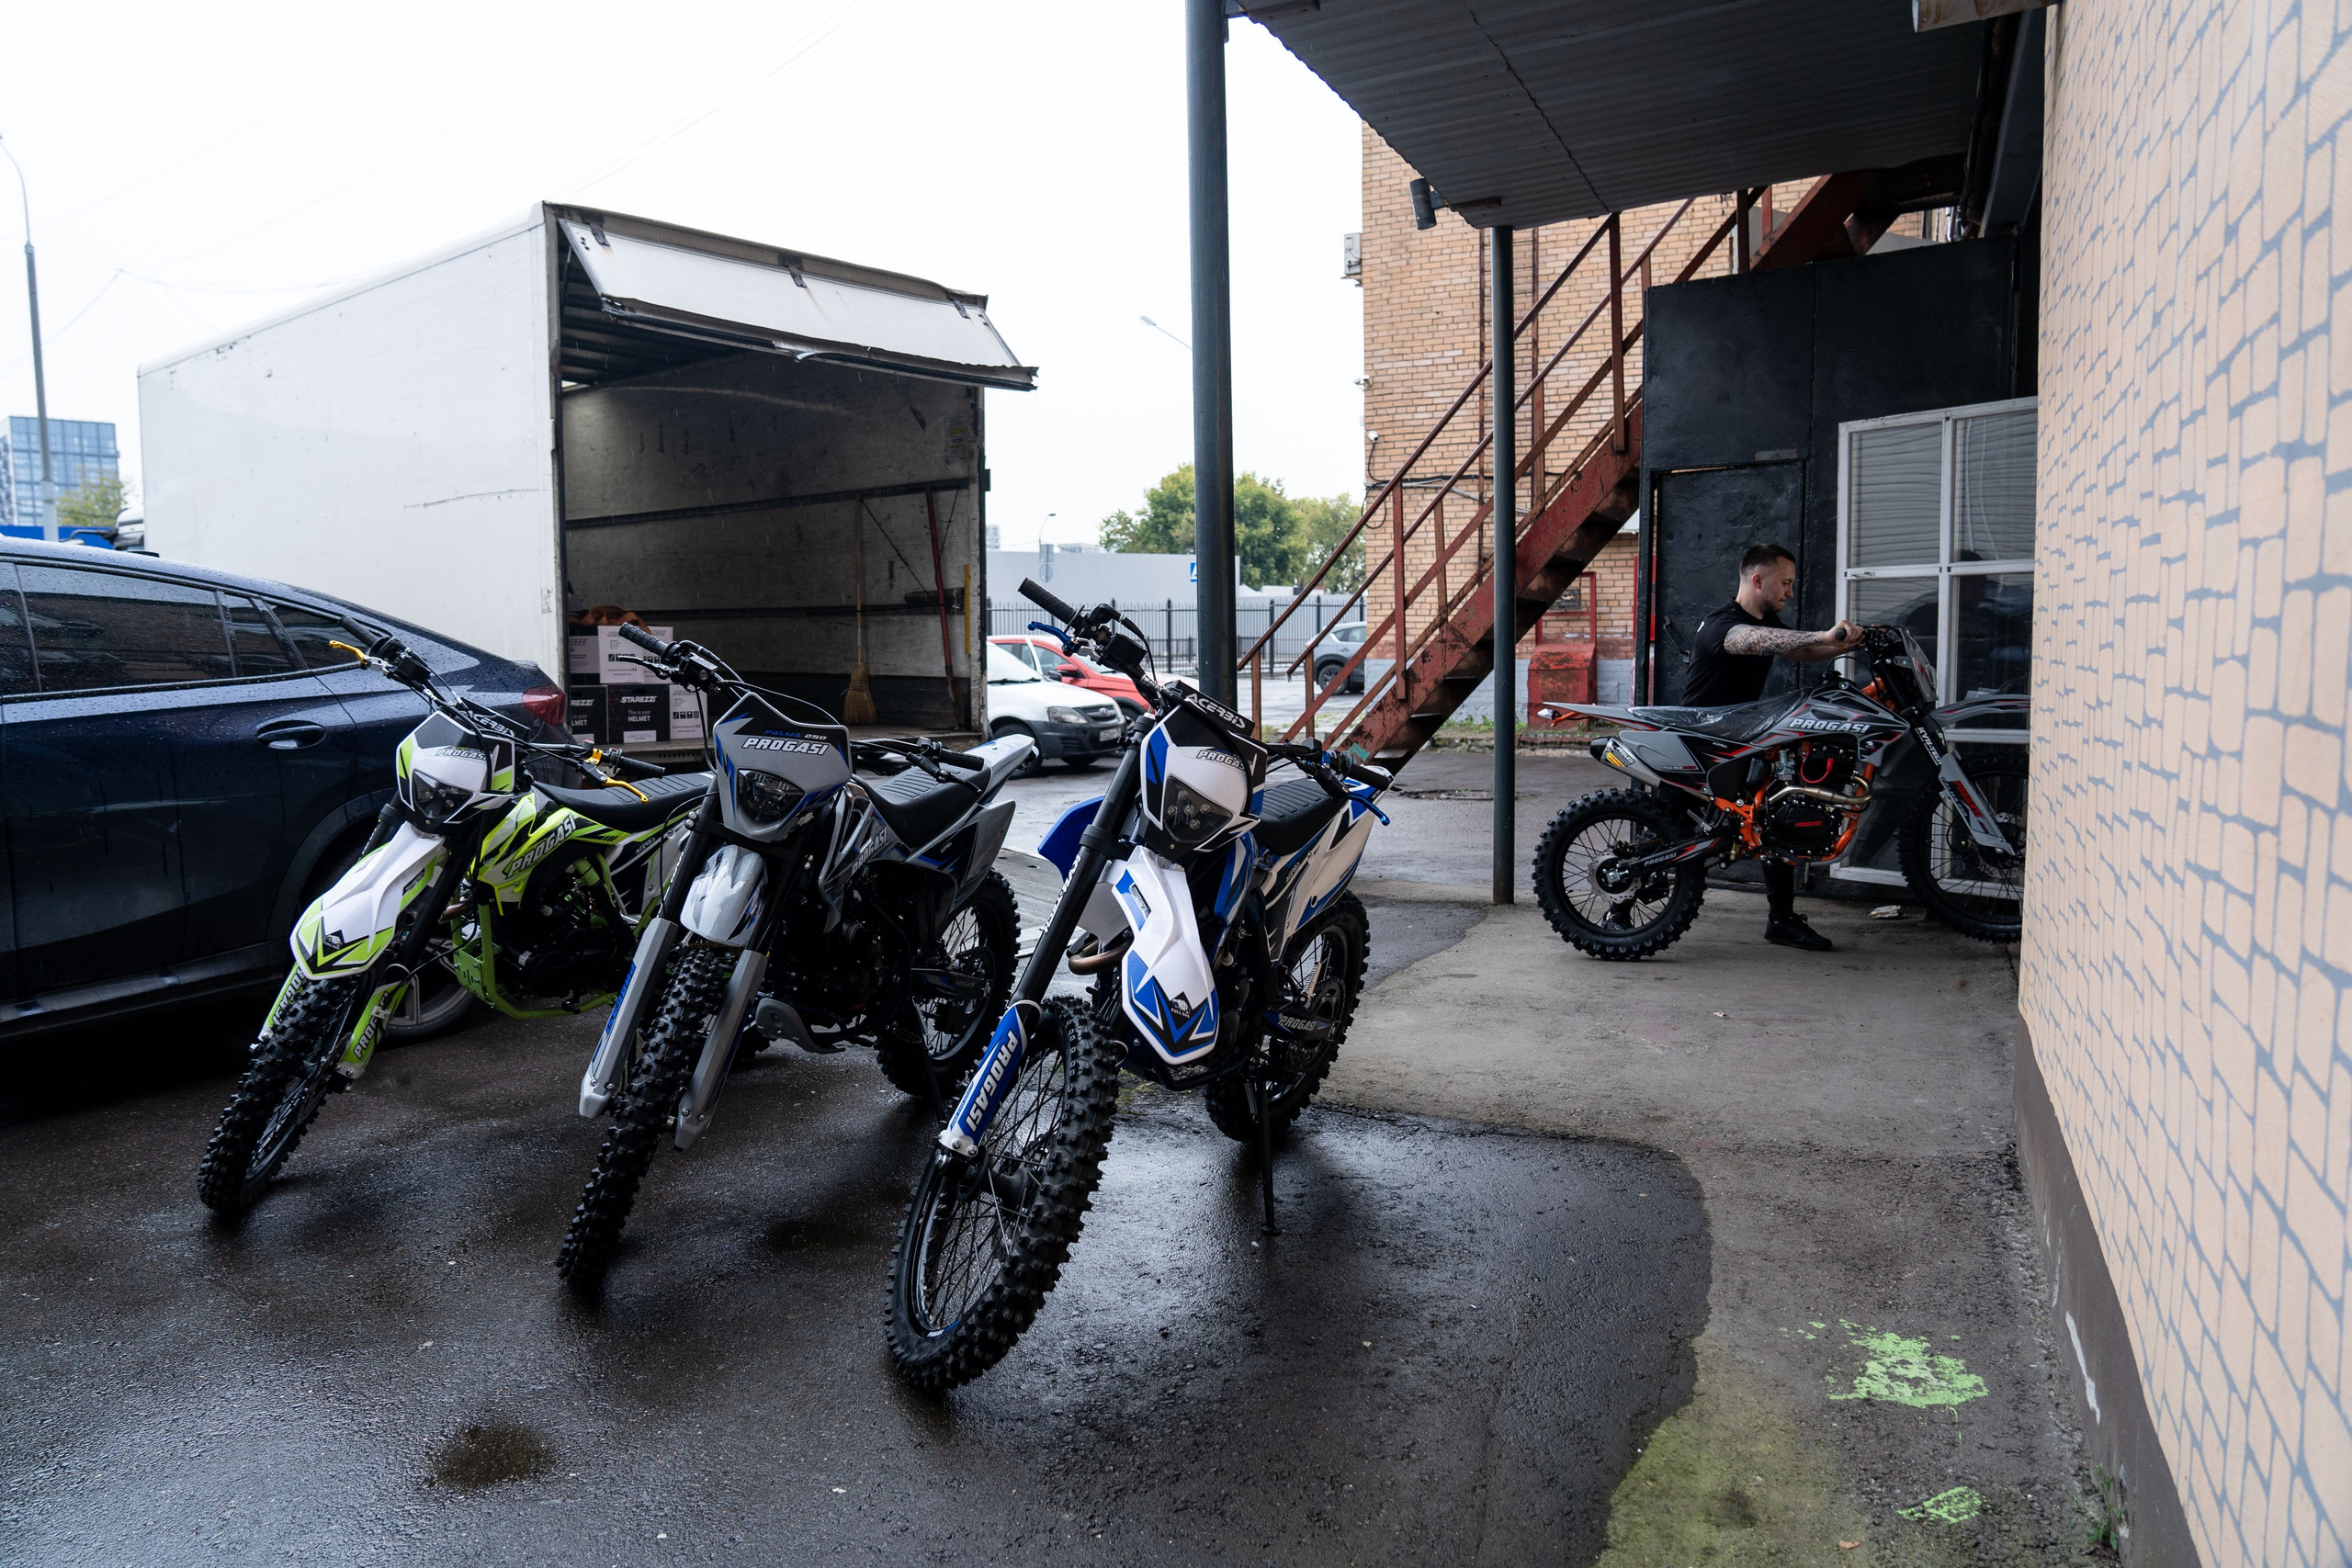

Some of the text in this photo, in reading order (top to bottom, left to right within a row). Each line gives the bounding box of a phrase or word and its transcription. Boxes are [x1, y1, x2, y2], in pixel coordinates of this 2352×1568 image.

[1185, 693, 1246, 728] ACERBIS
[764, 729, 801, 739] PALMA
[1789, 718, 1871, 734] PROGASI
[742, 737, 829, 755] PROGASI
[1196, 750, 1245, 771] PROGAS
[1952, 780, 1983, 818] PROGASI
[508, 813, 577, 879] PROGASI
[1644, 852, 1677, 866] PROGASI
[1170, 1008, 1182, 1016] FULL
[1278, 1015, 1317, 1031] PROGASI
[966, 1030, 1019, 1132] PROGASI
